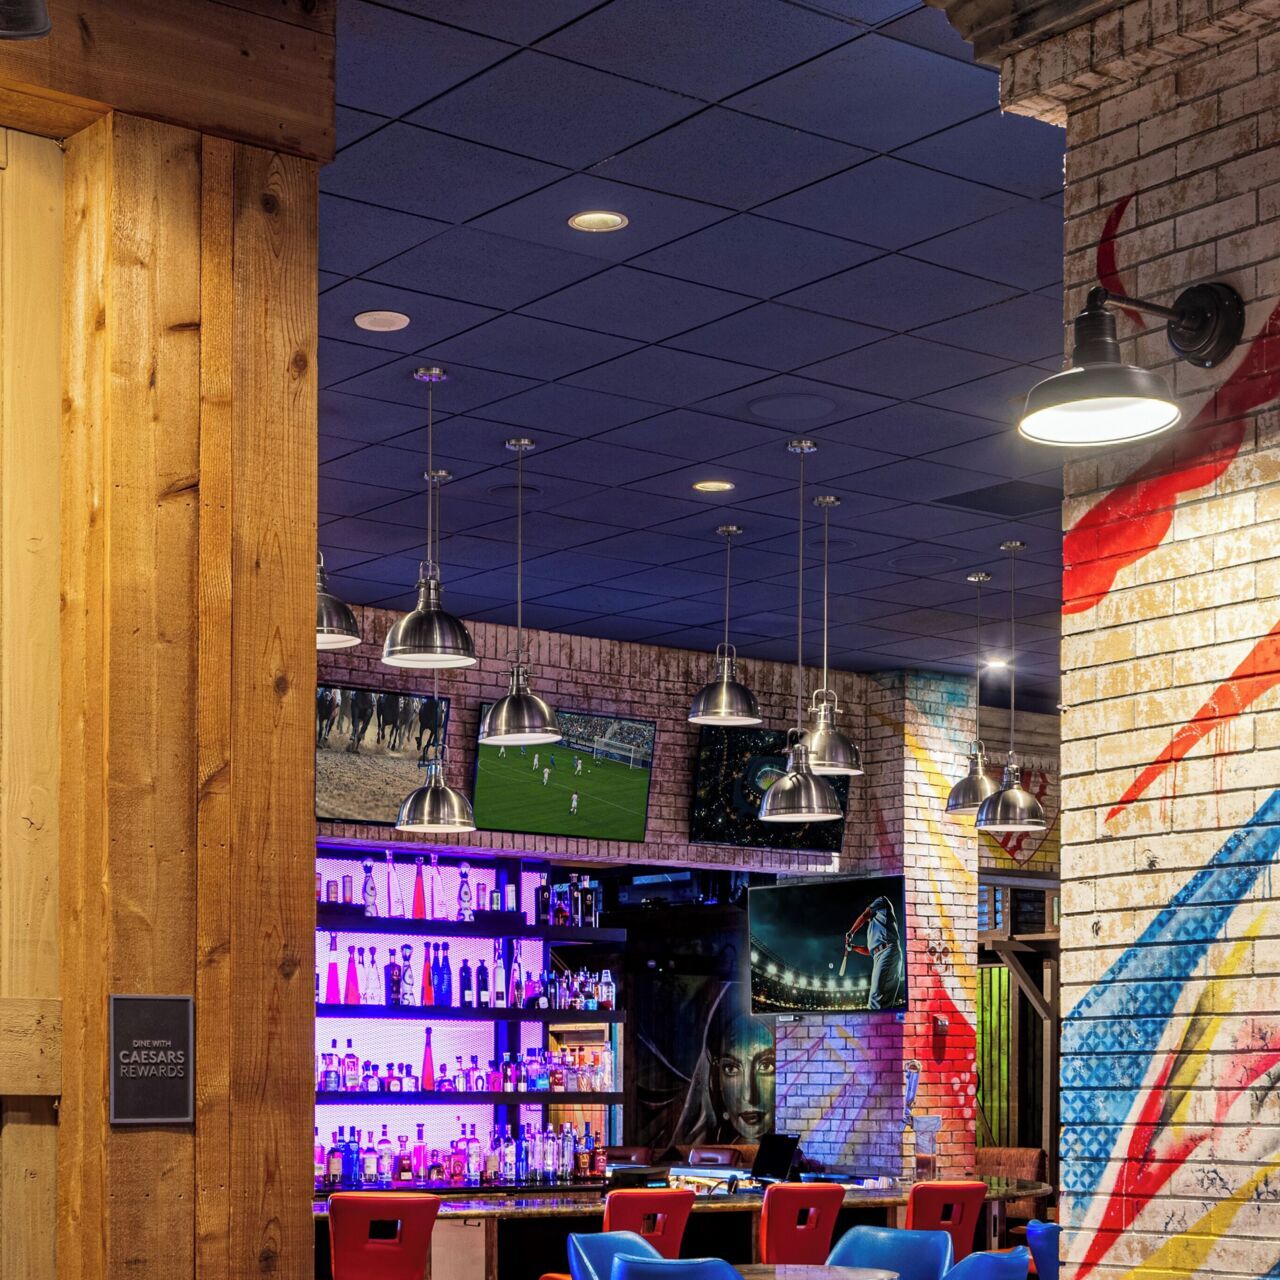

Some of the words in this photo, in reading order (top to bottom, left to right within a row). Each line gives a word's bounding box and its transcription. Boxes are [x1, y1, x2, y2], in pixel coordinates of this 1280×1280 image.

[132, 1039, 151, 1048] DINE
[151, 1039, 172, 1048] WITH
[119, 1050, 185, 1064] CAESARS
[120, 1065, 185, 1078] REWARDS
